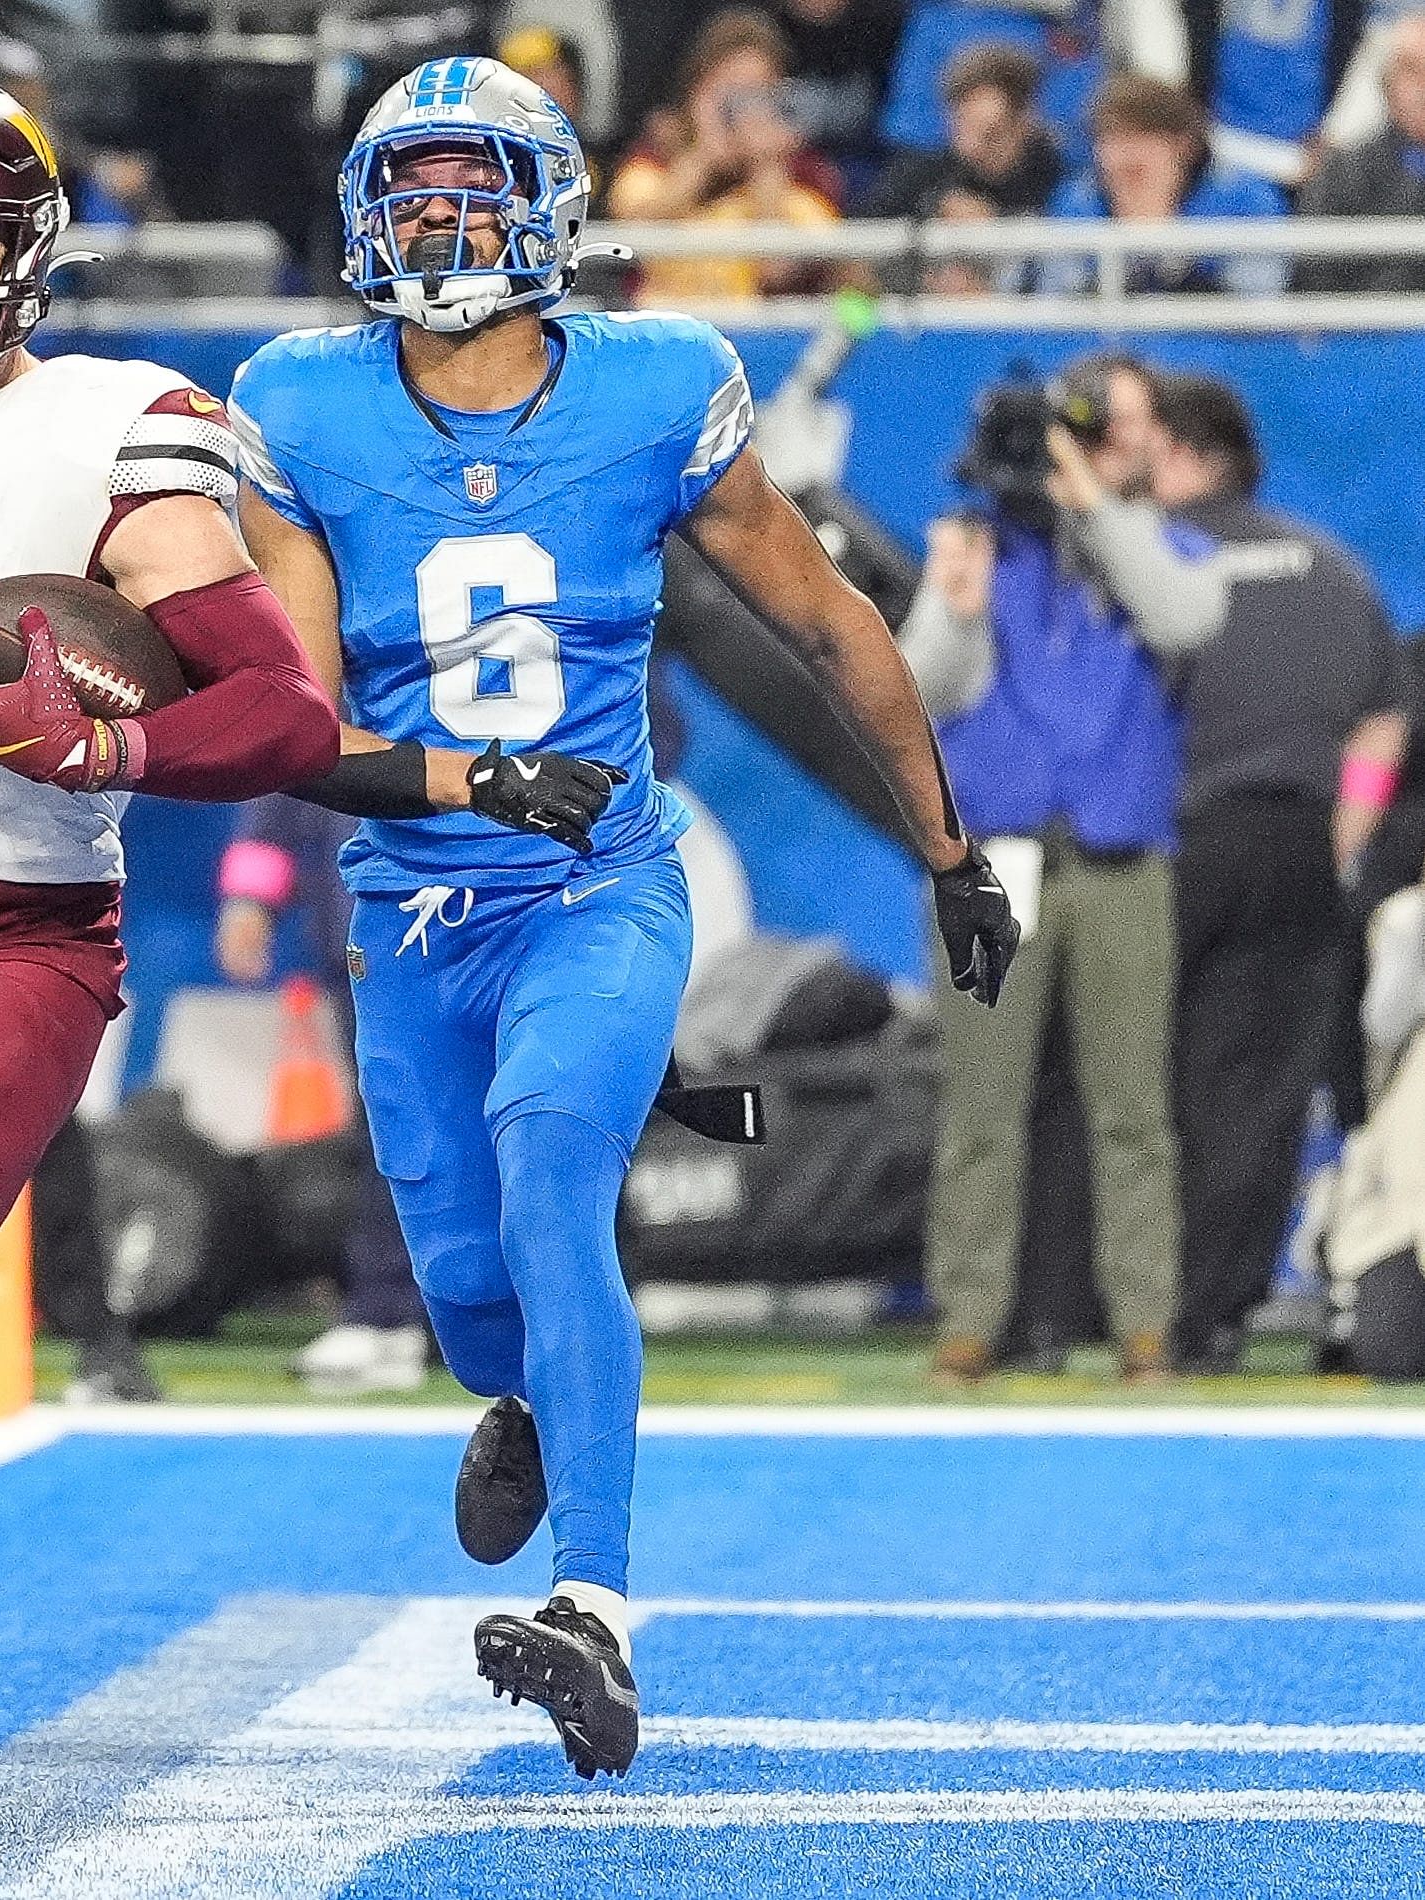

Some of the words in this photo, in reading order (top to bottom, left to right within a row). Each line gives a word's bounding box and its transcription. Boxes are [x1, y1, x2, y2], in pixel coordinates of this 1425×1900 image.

[415, 106, 455, 117] LIONS
[470, 480, 492, 496] NFL
[415, 532, 566, 741] 6
